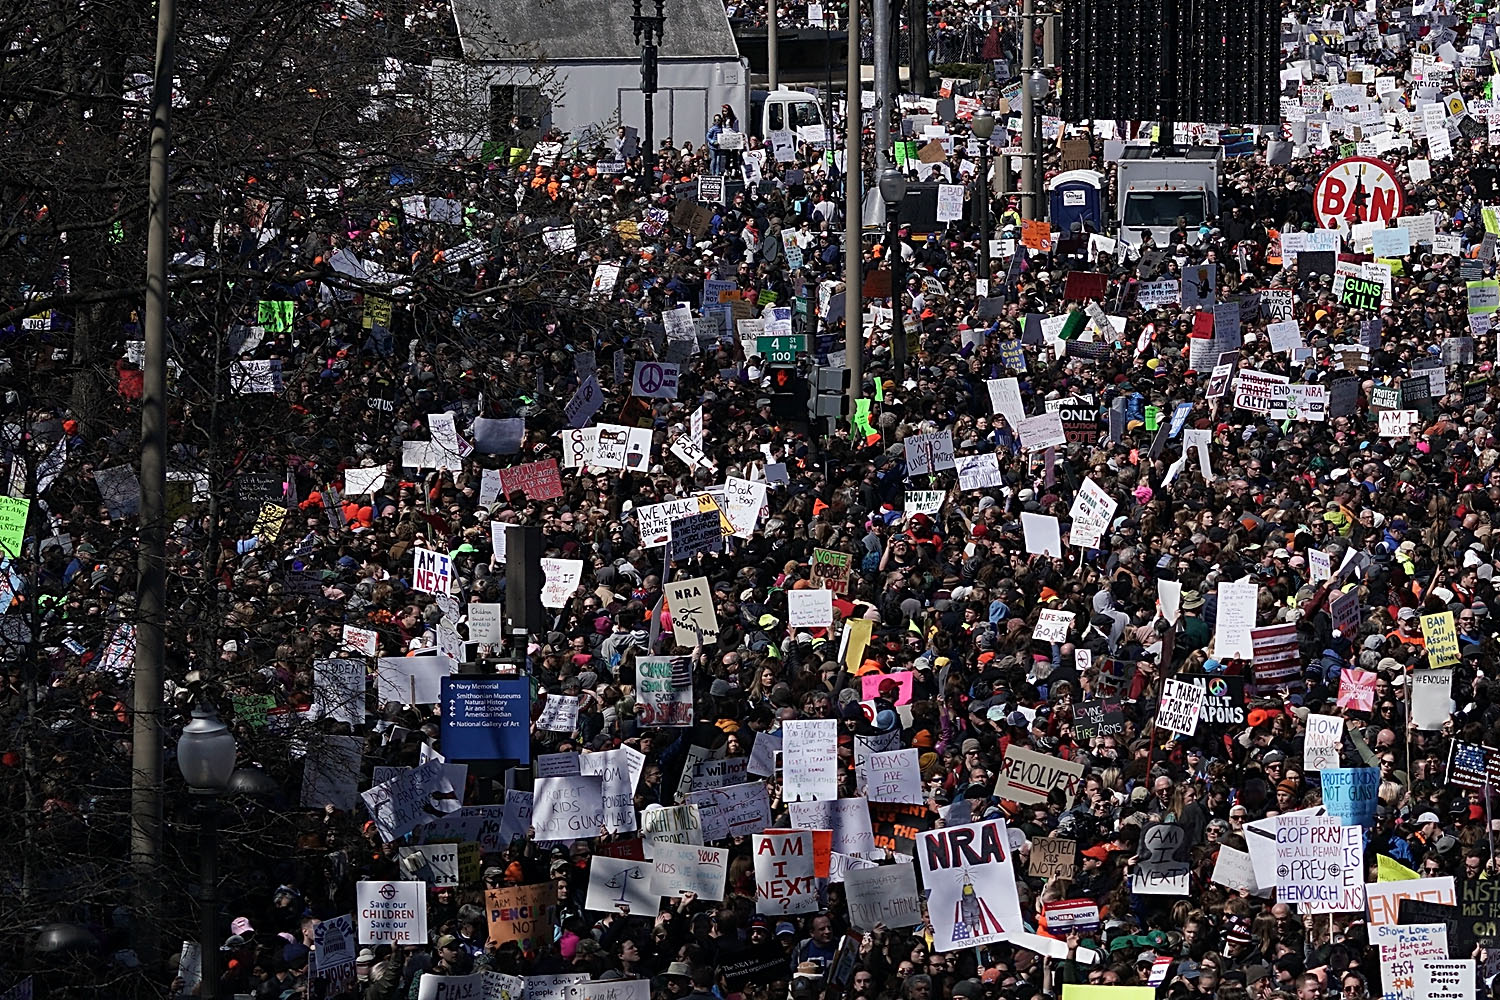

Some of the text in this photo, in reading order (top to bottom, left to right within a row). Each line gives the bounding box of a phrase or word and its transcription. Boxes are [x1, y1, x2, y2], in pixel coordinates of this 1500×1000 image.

[1321, 177, 1396, 225] BAN
[1345, 278, 1381, 297] GUNS
[1342, 291, 1378, 310] KILL
[771, 338, 779, 349] 4
[771, 352, 790, 360] 100
[1273, 385, 1291, 395] END
[1305, 386, 1323, 398] NRA
[1373, 388, 1399, 400] PROTECT
[1372, 397, 1398, 409] CHILDREN
[1060, 408, 1098, 421] ONLY
[418, 550, 449, 576] AM I
[416, 568, 449, 593] NEXT
[457, 683, 472, 691] Navy
[1416, 675, 1450, 685] #ENOUGH
[1164, 680, 1200, 703] I MARCH
[1168, 698, 1193, 714] FOR MY
[1159, 710, 1193, 732] NEPHEWS
[1001, 756, 1080, 797] REVOLVER
[1277, 816, 1334, 826] WHILE THE
[1148, 828, 1179, 844] AM
[1277, 826, 1342, 844] GOP PRAY
[758, 836, 804, 857] AM
[925, 822, 1006, 871] NRA
[1278, 846, 1341, 858] WE ALL REMAIN
[1151, 847, 1170, 864] I
[773, 862, 787, 878] I
[1290, 858, 1326, 881] PREY
[1134, 868, 1188, 888] NEXT?
[758, 876, 815, 899] NEXT
[1277, 884, 1338, 900] #ENOUGH
[370, 901, 390, 909] Save
[1463, 903, 1483, 918] has
[362, 909, 414, 919] CHILDREN
[371, 920, 390, 929] Save
[1473, 923, 1496, 937] on
[370, 931, 410, 941] FUTURE
[957, 934, 994, 948] INSANITY
[1430, 977, 1460, 985] Policy
